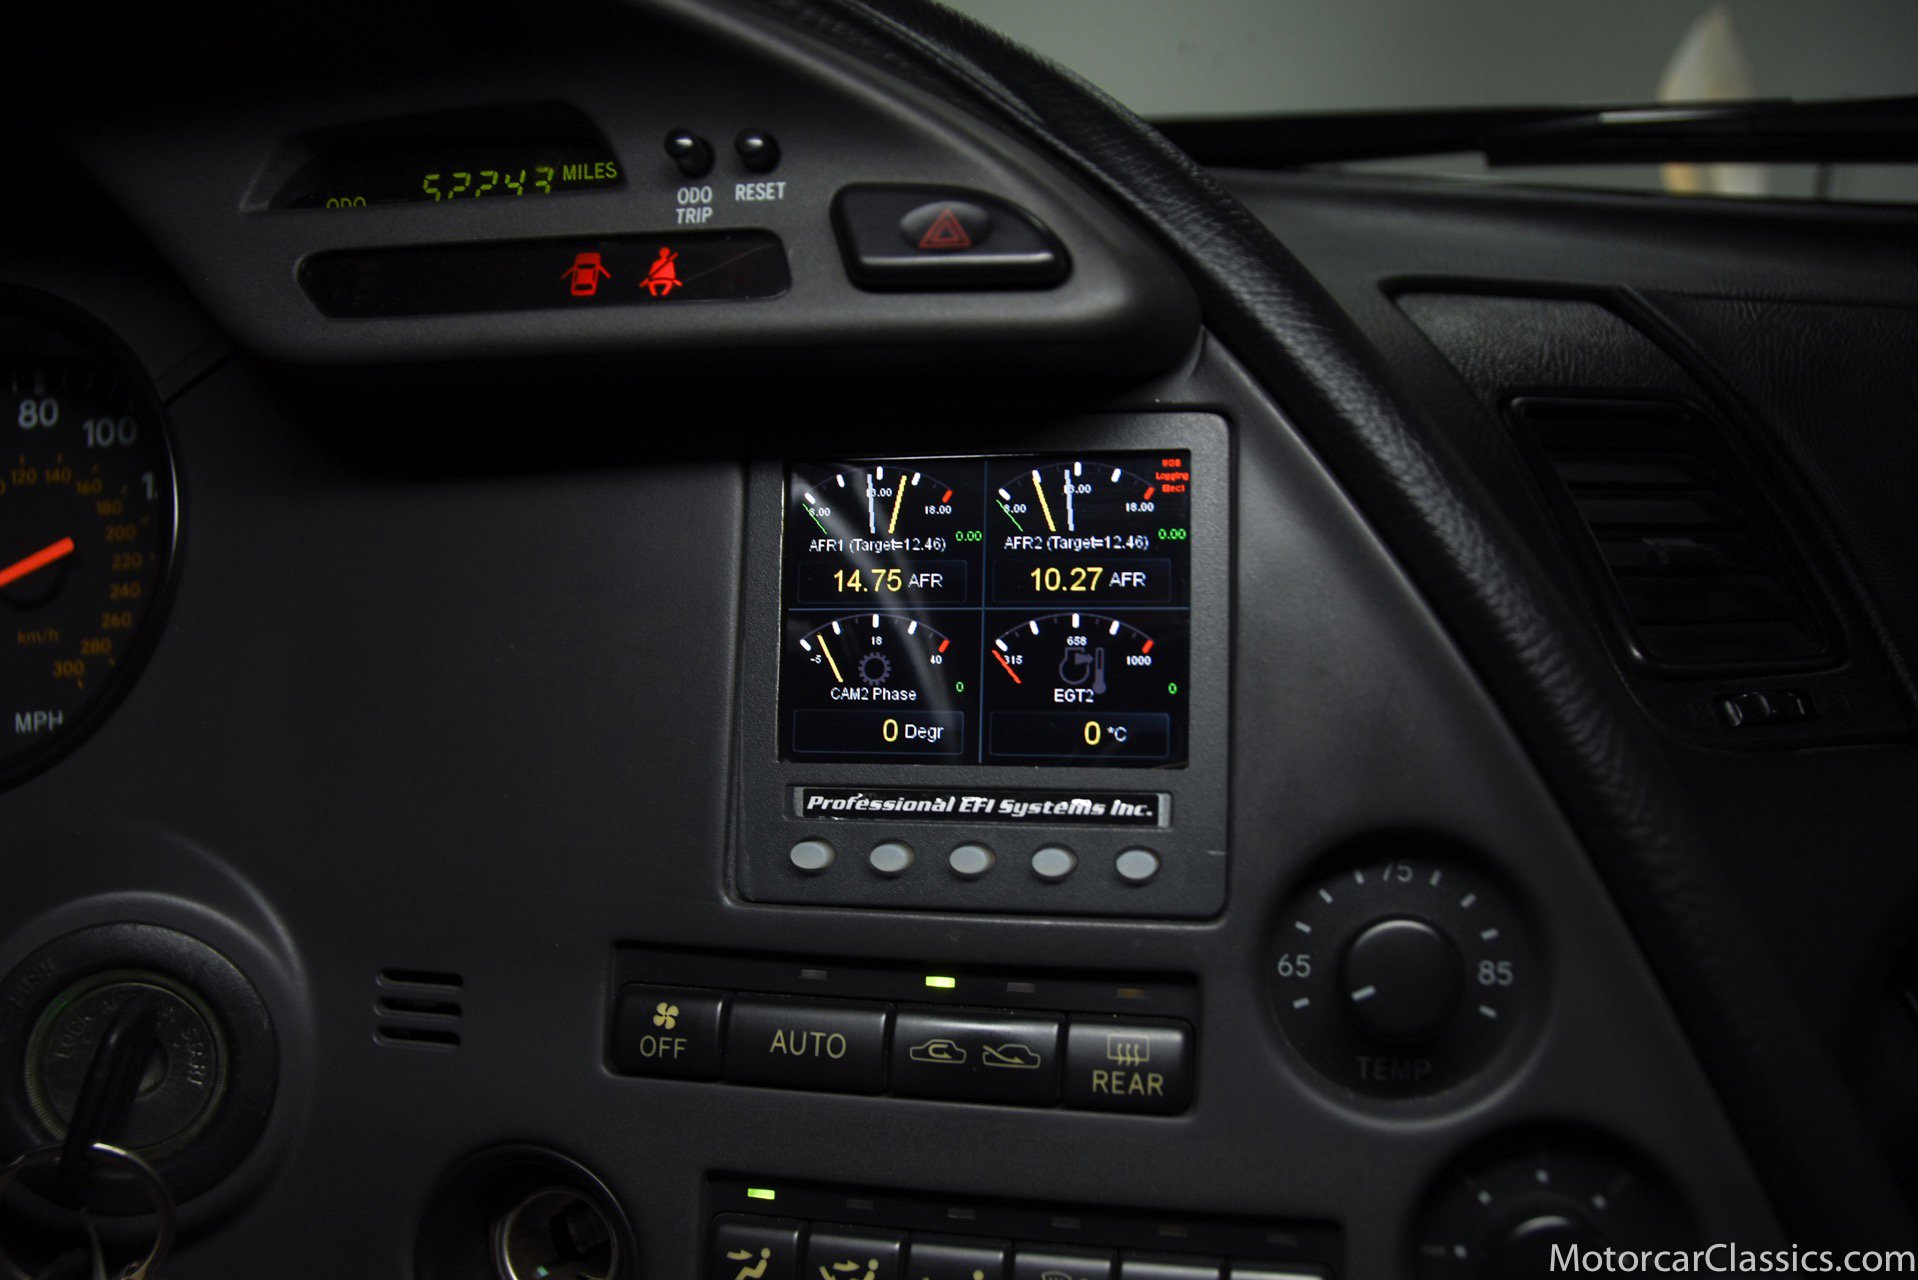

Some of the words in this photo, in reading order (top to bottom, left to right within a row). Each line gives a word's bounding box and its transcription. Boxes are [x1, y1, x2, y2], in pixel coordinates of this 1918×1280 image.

[562, 161, 618, 183] MILES
[677, 187, 714, 206] ODO
[735, 181, 786, 203] RESET
[676, 206, 714, 224] TRIP
[17, 398, 61, 430] 80
[82, 416, 139, 448] 100
[11, 468, 38, 486] 120
[45, 466, 73, 484] 140
[924, 505, 952, 515] 18.00
[1125, 502, 1155, 513] 18.00
[105, 524, 139, 543] 200
[955, 530, 982, 542] 0.00
[1004, 536, 1043, 550] AFR2
[1046, 535, 1150, 551] (Target=12.46)
[1158, 528, 1187, 540] 0.00
[808, 539, 844, 552] AFR1
[849, 537, 947, 554] (Target=12.46)
[111, 552, 144, 570] 220
[833, 569, 903, 593] 14.75
[907, 573, 944, 588] AFR
[1030, 567, 1103, 592] 10.27
[1108, 572, 1147, 587] AFR
[110, 581, 143, 599] 240
[102, 612, 133, 631] 260
[17, 627, 60, 646] km/h
[871, 636, 883, 646] 18
[1066, 636, 1087, 647] 658
[80, 637, 113, 656] 280
[52, 658, 86, 679] 300
[930, 654, 943, 665] 40
[1126, 655, 1152, 666] 1000
[830, 687, 869, 701] CAM2
[872, 687, 917, 701] Phase
[956, 681, 964, 693] 0
[1053, 688, 1095, 703] EGT2
[1168, 682, 1177, 695] 0
[14, 710, 64, 735] MPH
[882, 718, 899, 743] 0
[904, 723, 944, 743] Degr
[1084, 720, 1101, 746] 0
[807, 793, 955, 813] Professional
[958, 796, 996, 813] EFI
[997, 798, 1107, 818] Systems
[1109, 799, 1154, 817] Inc.
[1276, 953, 1312, 978] 65
[1476, 959, 1515, 987] 85
[639, 1035, 687, 1059] OFF
[769, 1028, 847, 1060] AUTO
[1355, 1055, 1432, 1082] TEMP
[1091, 1069, 1164, 1096] REAR
